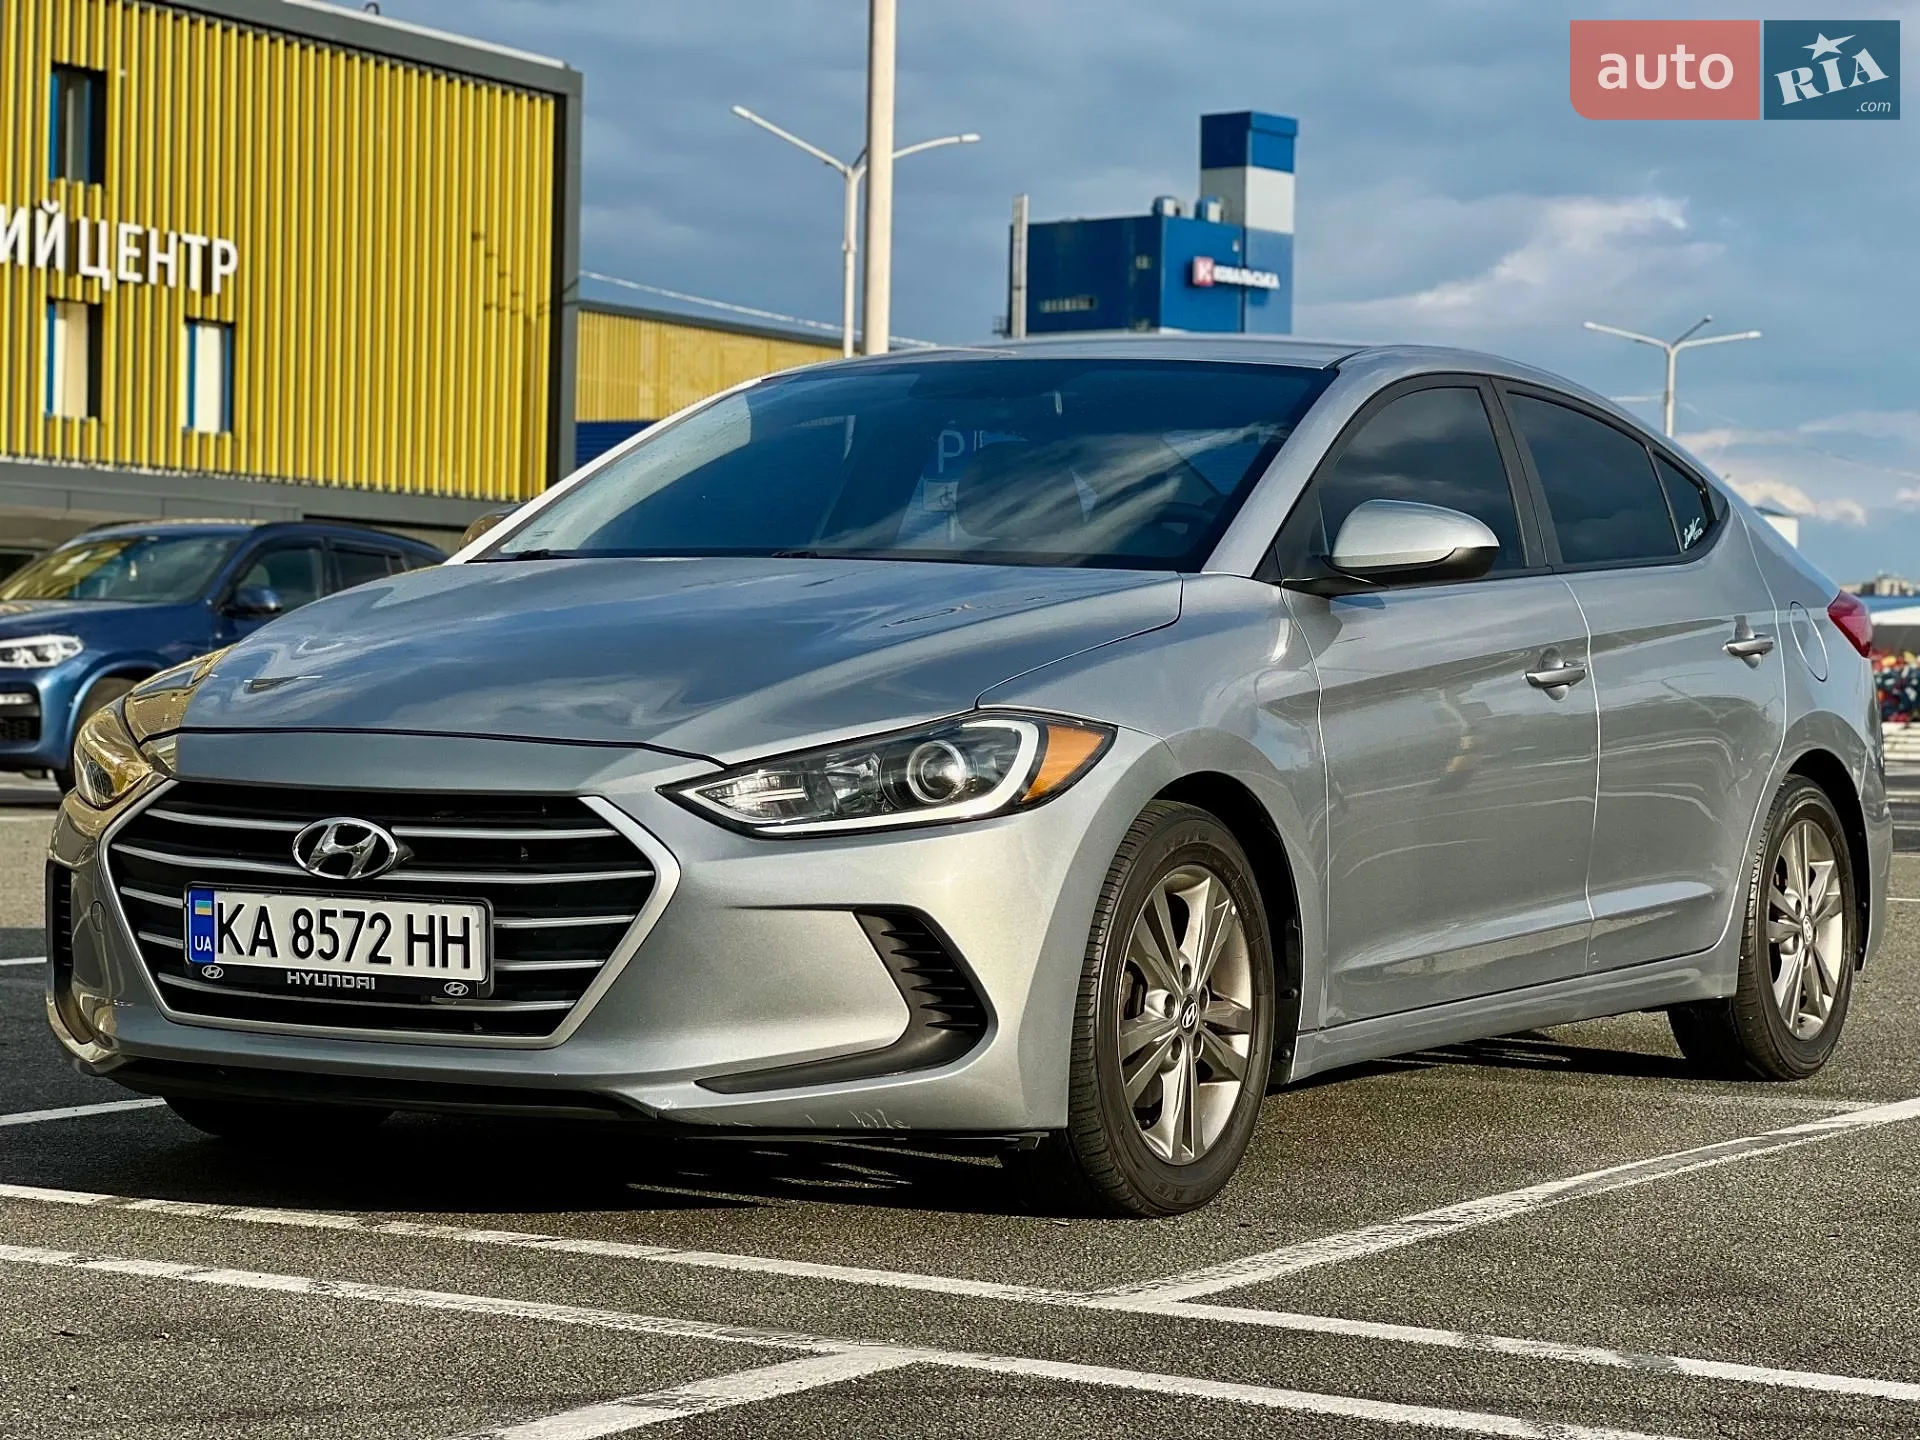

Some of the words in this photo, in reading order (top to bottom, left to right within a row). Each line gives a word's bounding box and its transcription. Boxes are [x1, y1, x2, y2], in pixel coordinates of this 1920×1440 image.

[78, 215, 238, 295] ЦЕНТР
[194, 935, 213, 952] UA
[217, 902, 278, 958] KA
[291, 908, 392, 965] 8572
[406, 913, 471, 969] HH
[286, 971, 376, 990] HYUNDAI
